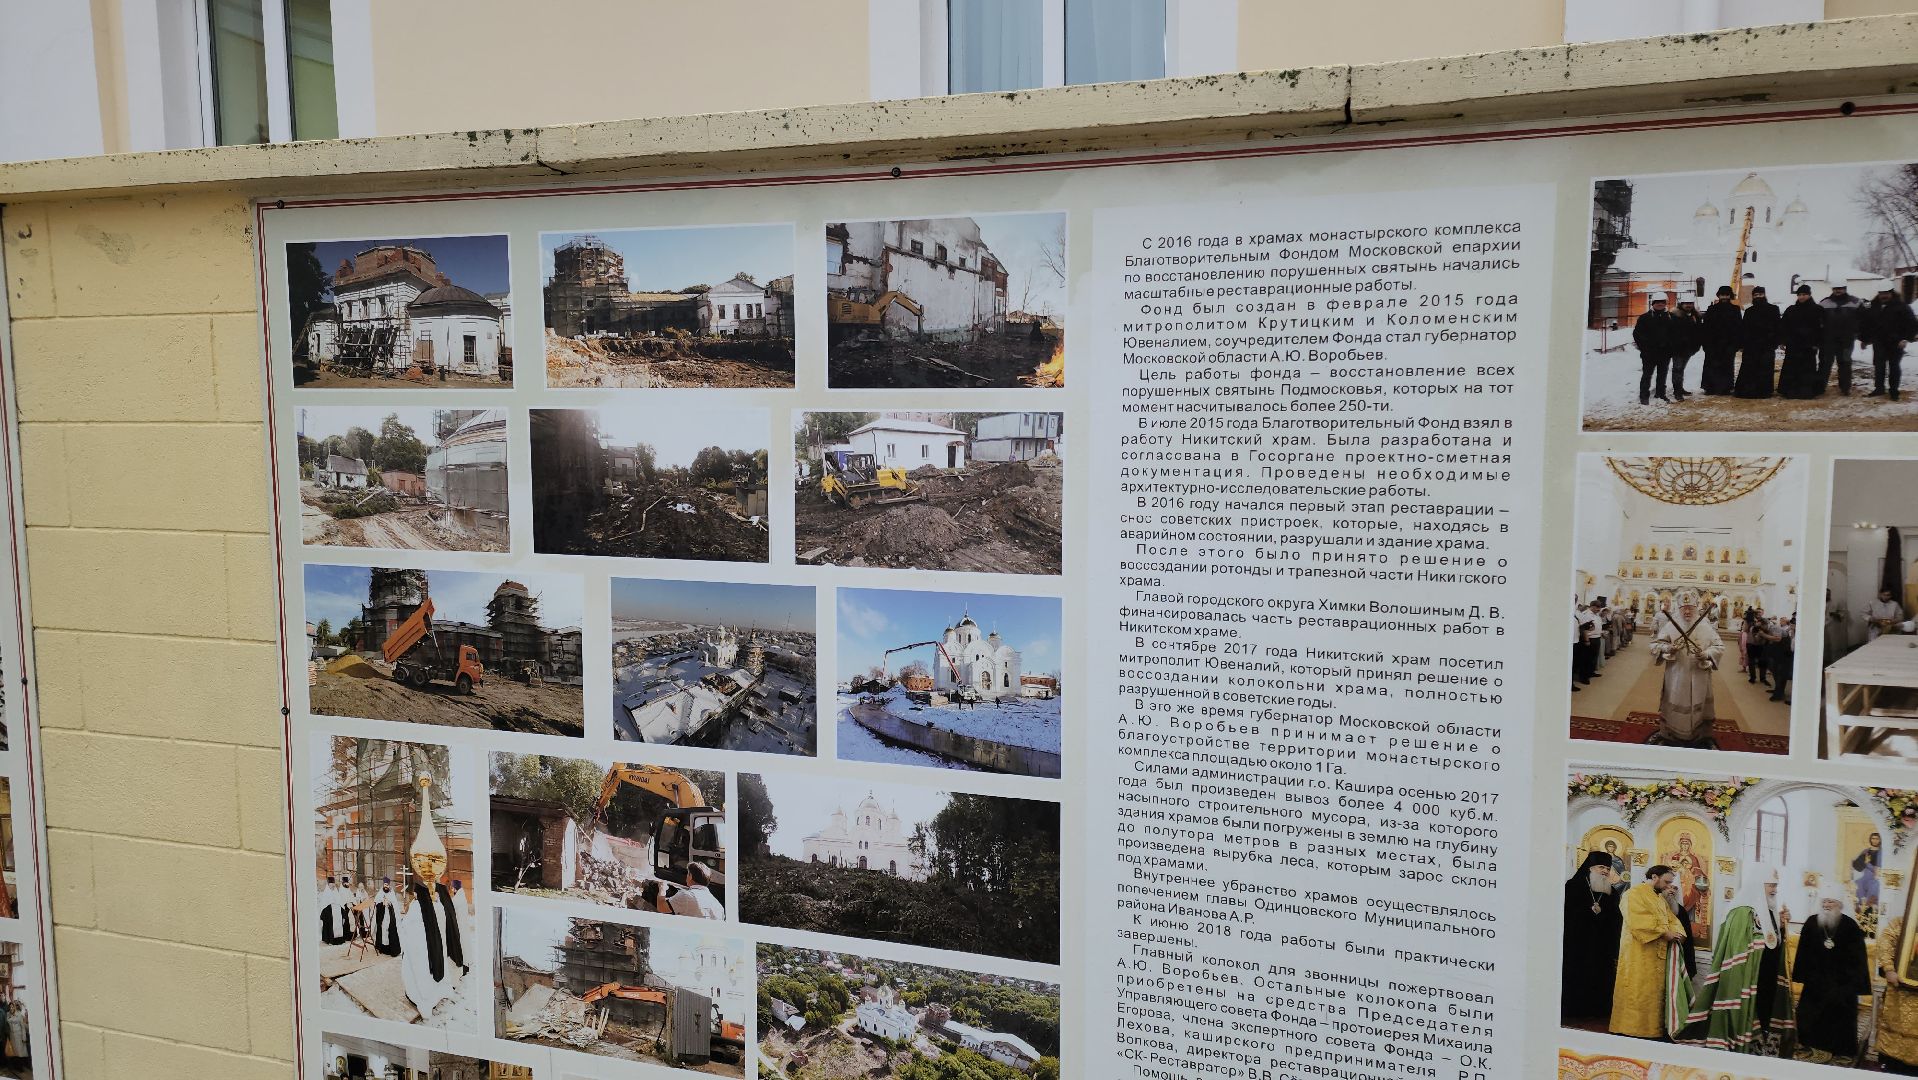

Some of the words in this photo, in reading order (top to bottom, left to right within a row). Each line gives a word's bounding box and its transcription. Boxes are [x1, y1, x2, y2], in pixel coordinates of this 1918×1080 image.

[1157, 235, 1192, 249] 2016
[1197, 236, 1229, 249] года
[1248, 233, 1304, 247] храмах
[1309, 227, 1428, 242] монастырского
[1434, 222, 1521, 236] комплекса
[1279, 247, 1339, 262] Фондом
[1348, 241, 1443, 258] Московской
[1452, 240, 1521, 256] епархии
[1145, 269, 1265, 283] восстановлению
[1270, 264, 1367, 281] порушенных
[1371, 262, 1438, 274] святынь
[1442, 258, 1521, 272] начались
[1217, 282, 1353, 300] реставрационные
[1355, 278, 1417, 295] работы.
[1140, 304, 1183, 317] Фонд
[1192, 301, 1225, 315] был
[1235, 301, 1296, 315] создан
[1326, 298, 1408, 313] феврале
[1419, 293, 1464, 307] 2015
[1476, 294, 1518, 307] года
[1123, 351, 1206, 365] Московской
[1208, 350, 1267, 364] области
[1269, 349, 1305, 363] А.Ю.
[1308, 348, 1387, 364] Воробьев.
[1139, 368, 1177, 384] Цель
[1185, 367, 1240, 383] работы
[1250, 366, 1301, 382] фонда
[1329, 366, 1466, 378] восстановление
[1476, 366, 1515, 376] всех
[1215, 386, 1275, 397] святынь
[1280, 383, 1387, 397] Подмосковья,
[1393, 384, 1459, 398] которых
[1488, 384, 1514, 394] тот
[1189, 416, 1224, 429] 2015
[1226, 419, 1258, 431] года
[1262, 416, 1415, 432] Благотворительный
[1417, 416, 1460, 431] Фонд
[1463, 419, 1500, 429] взял
[1181, 433, 1262, 446] Никитский
[1272, 435, 1316, 448] храм.
[1327, 433, 1370, 446] Была
[1380, 433, 1492, 449] разработана
[1249, 449, 1335, 465] Госоргане
[1345, 453, 1511, 466] проектно-сметная
[1261, 466, 1365, 481] Проведены
[1377, 467, 1511, 483] необходимые
[1151, 496, 1185, 509] 2016
[1189, 500, 1220, 513] году
[1224, 500, 1284, 511] начался
[1289, 500, 1346, 515] первый
[1351, 503, 1385, 514] этап
[1390, 503, 1494, 518] реставрации
[1160, 515, 1232, 526] советских
[1332, 519, 1403, 533] которые,
[1413, 521, 1490, 534] находясь
[1136, 543, 1188, 557] После
[1198, 548, 1244, 559] этого
[1255, 547, 1301, 561] было
[1312, 551, 1388, 564] принято
[1400, 554, 1486, 567] решение
[1119, 576, 1165, 587] храма.
[1211, 564, 1272, 577] ротонды
[1287, 567, 1366, 580] трапезной
[1369, 570, 1414, 581] части
[1136, 590, 1184, 604] Главой
[1187, 595, 1265, 608] городского
[1267, 598, 1315, 612] округа
[1318, 598, 1366, 612] Химки
[1223, 642, 1258, 656] 2017
[1265, 647, 1298, 660] года
[1306, 647, 1384, 663] Никитский
[1391, 654, 1431, 668] храм
[1439, 657, 1504, 670] посетил
[1119, 653, 1201, 668] митрополит
[1205, 656, 1285, 675] Ювеналий,
[1290, 664, 1352, 679] который
[1356, 668, 1412, 681] принял
[1417, 672, 1488, 687] решение
[1118, 713, 1159, 727] А.Ю.
[1170, 716, 1260, 735] Воробьев
[1389, 737, 1479, 753] решение
[1201, 706, 1244, 719] время
[1339, 714, 1430, 733] Московской
[1436, 722, 1501, 739] области
[1118, 728, 1250, 751] благоустройстве
[1259, 742, 1356, 760] территории
[1134, 760, 1188, 776] Силами
[1191, 768, 1304, 788] администрации
[1335, 778, 1394, 798] Кашира
[1398, 787, 1457, 801] осенью
[1460, 790, 1500, 805] 2017
[1118, 776, 1147, 789] года
[1191, 783, 1276, 801] произведен
[1285, 792, 1330, 806] вывоз
[1338, 795, 1385, 811] более
[1450, 807, 1498, 822] куб.м.
[1117, 807, 1165, 821] здания
[1168, 812, 1219, 826] храмов
[1222, 815, 1260, 831] были
[1263, 822, 1343, 840] погружены
[1358, 832, 1409, 846] землю
[1436, 840, 1498, 858] глубину
[1198, 800, 1303, 819] строительного
[1311, 811, 1370, 828] мусора,
[1380, 818, 1420, 831] из-за
[1429, 822, 1498, 839] которого
[1144, 825, 1214, 843] полутора
[1224, 833, 1280, 849] метров
[1307, 843, 1367, 858] разных
[1376, 850, 1441, 868] местах,
[1452, 855, 1497, 872] была
[1118, 837, 1205, 856] произведена
[1327, 861, 1391, 877] которым
[1398, 869, 1444, 883] зарос
[1451, 875, 1497, 889] склон
[1206, 894, 1247, 908] главы
[1254, 897, 1357, 921] Одинцовского
[1364, 911, 1496, 939] Муниципального
[1150, 918, 1189, 931] июню
[1197, 921, 1232, 937] 2018
[1240, 929, 1272, 943] года
[1281, 935, 1336, 951] работы
[1345, 940, 1385, 957] были
[1394, 949, 1495, 972] практически
[1133, 943, 1193, 963] Главный
[1202, 955, 1260, 972] колокол
[1267, 964, 1296, 977] для
[1304, 969, 1379, 989] звонницы
[1388, 981, 1494, 1005] пожертвовал
[1116, 957, 1152, 973] А.Ю.
[1162, 962, 1244, 986] Воробьев.
[1253, 975, 1347, 999] Остальные
[1448, 1003, 1494, 1022] были
[1116, 986, 1218, 1012] Управляющего
[1220, 1004, 1268, 1020] совета
[1270, 1009, 1317, 1028] Фонда
[1332, 1020, 1420, 1043] протоиерея
[1423, 1032, 1493, 1055] Михаила
[1265, 996, 1346, 1016] средства
[1358, 1006, 1493, 1038] Председателя
[1117, 1001, 1175, 1023] Егорова,
[1230, 1021, 1318, 1043] экспертного
[1325, 1036, 1376, 1053] совета
[1383, 1043, 1433, 1062] Фонда
[1460, 1054, 1492, 1070] О.К.
